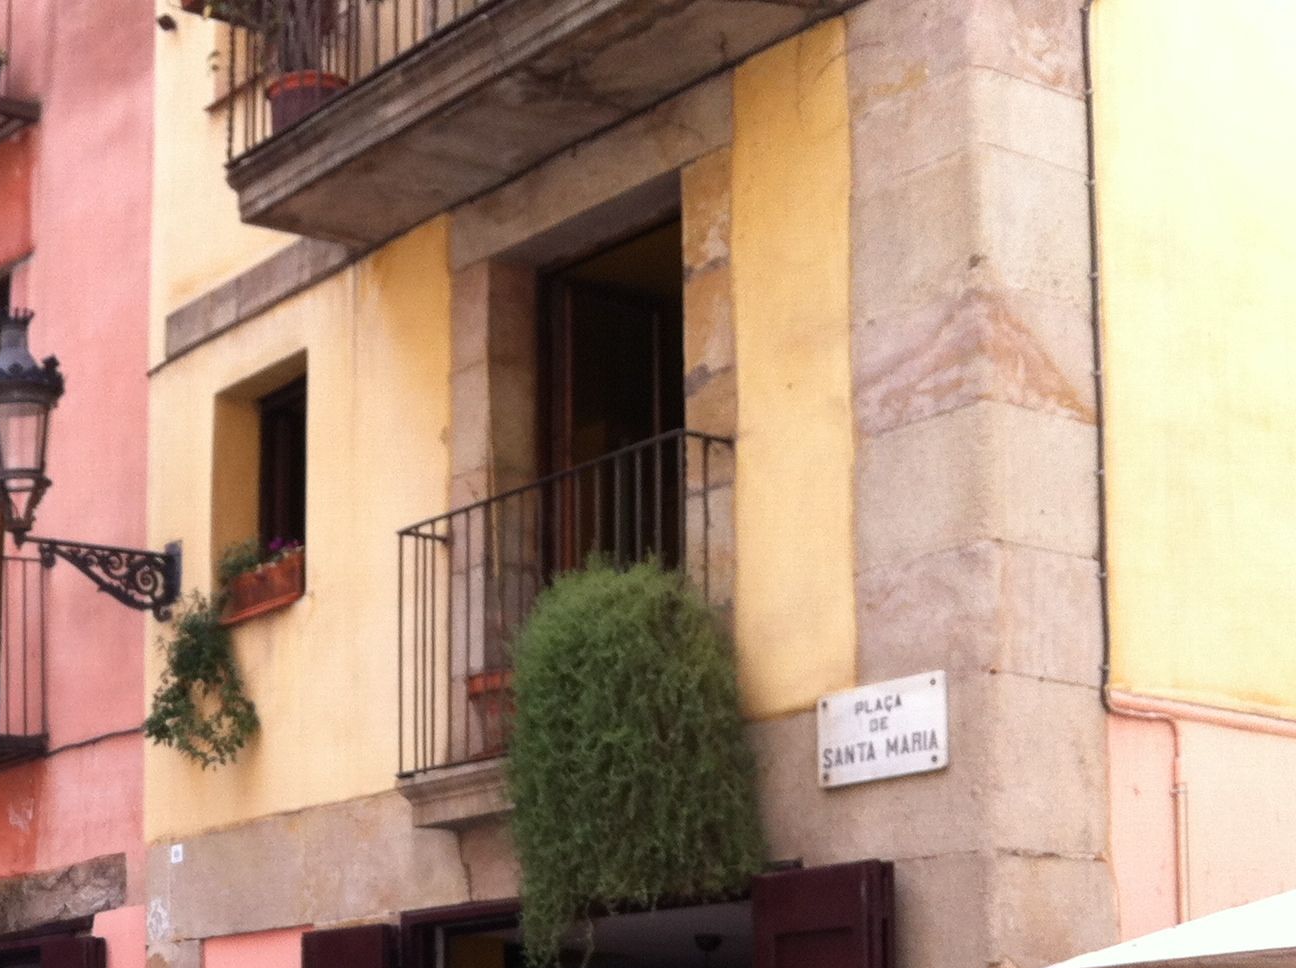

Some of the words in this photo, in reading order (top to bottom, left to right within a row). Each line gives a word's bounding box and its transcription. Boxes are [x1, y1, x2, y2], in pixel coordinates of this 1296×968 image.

[854, 693, 902, 715] PLAÇA
[869, 717, 888, 733] DE
[823, 741, 876, 769] SANTA
[885, 729, 938, 757] MARIA
